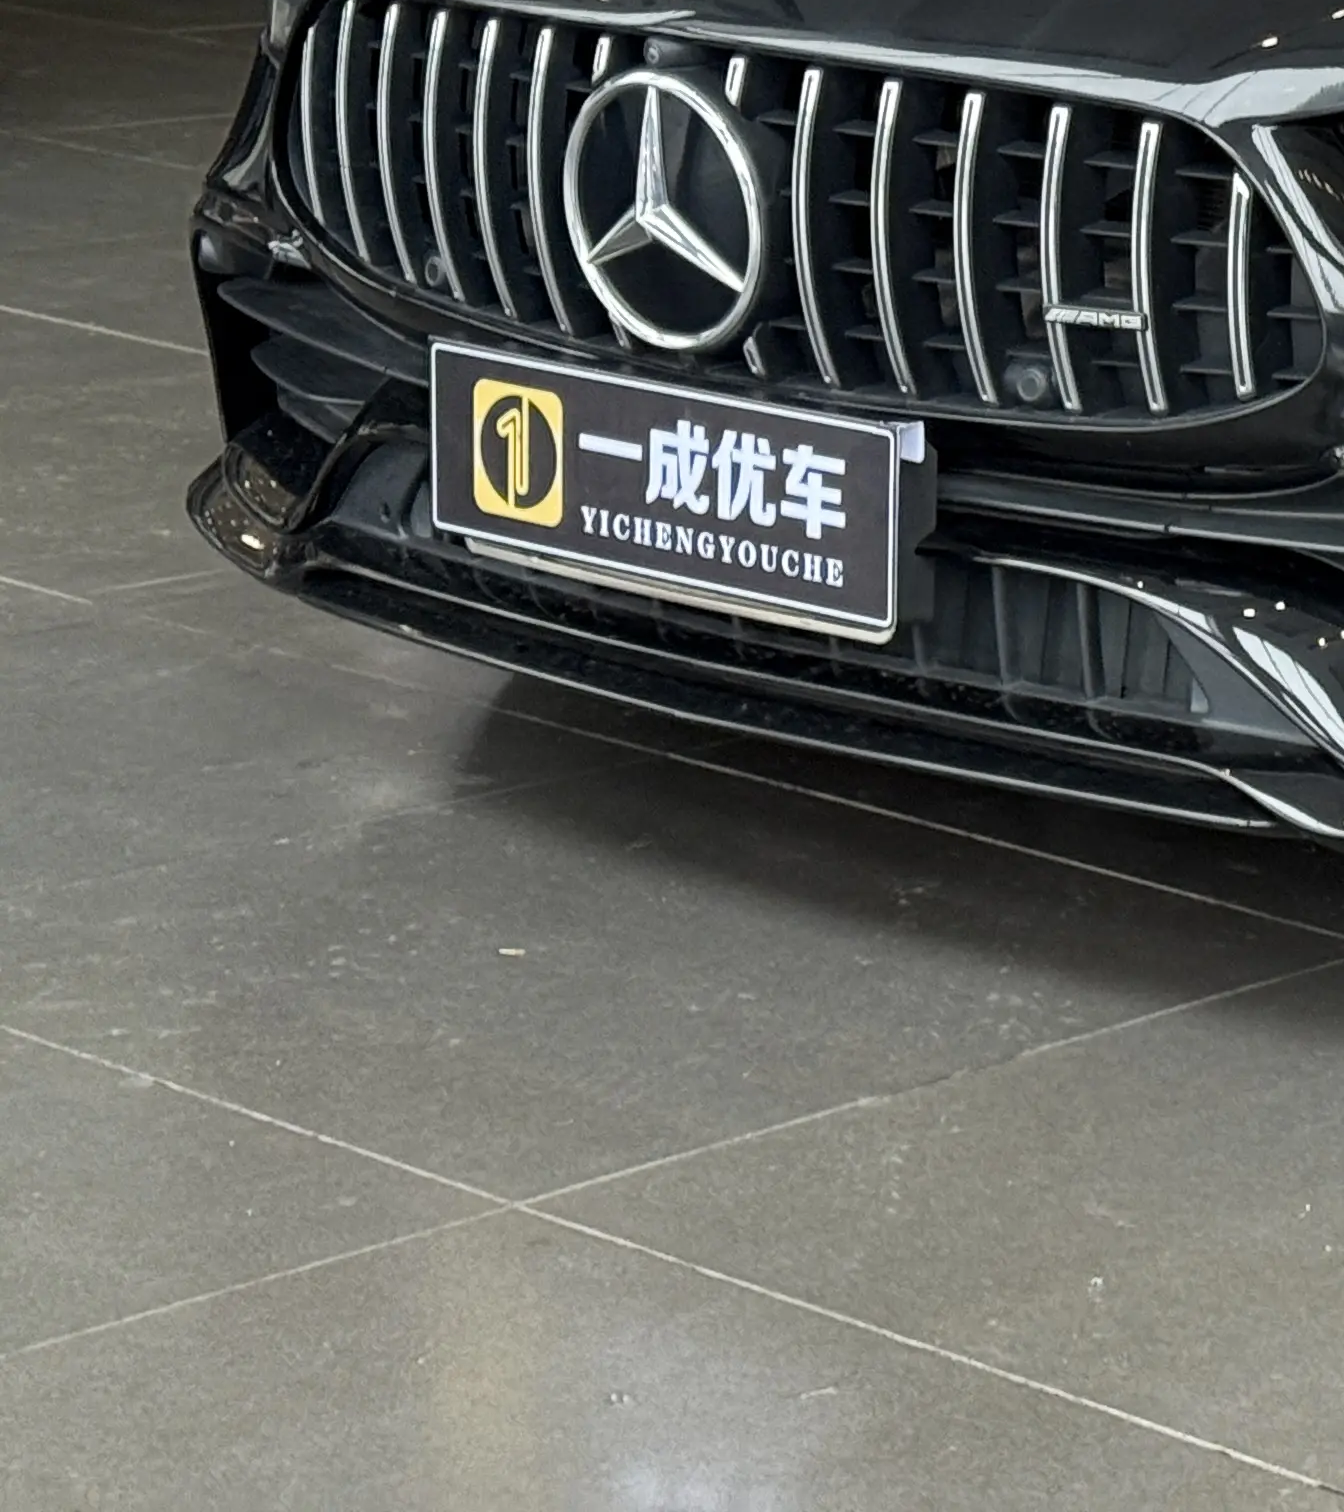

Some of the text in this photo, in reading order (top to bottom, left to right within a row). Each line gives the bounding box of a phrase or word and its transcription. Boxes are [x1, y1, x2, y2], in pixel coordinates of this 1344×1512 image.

[1070, 310, 1143, 330] AMG
[578, 419, 846, 540] 一成优车
[580, 505, 845, 588] YICHENGYOUCHE
